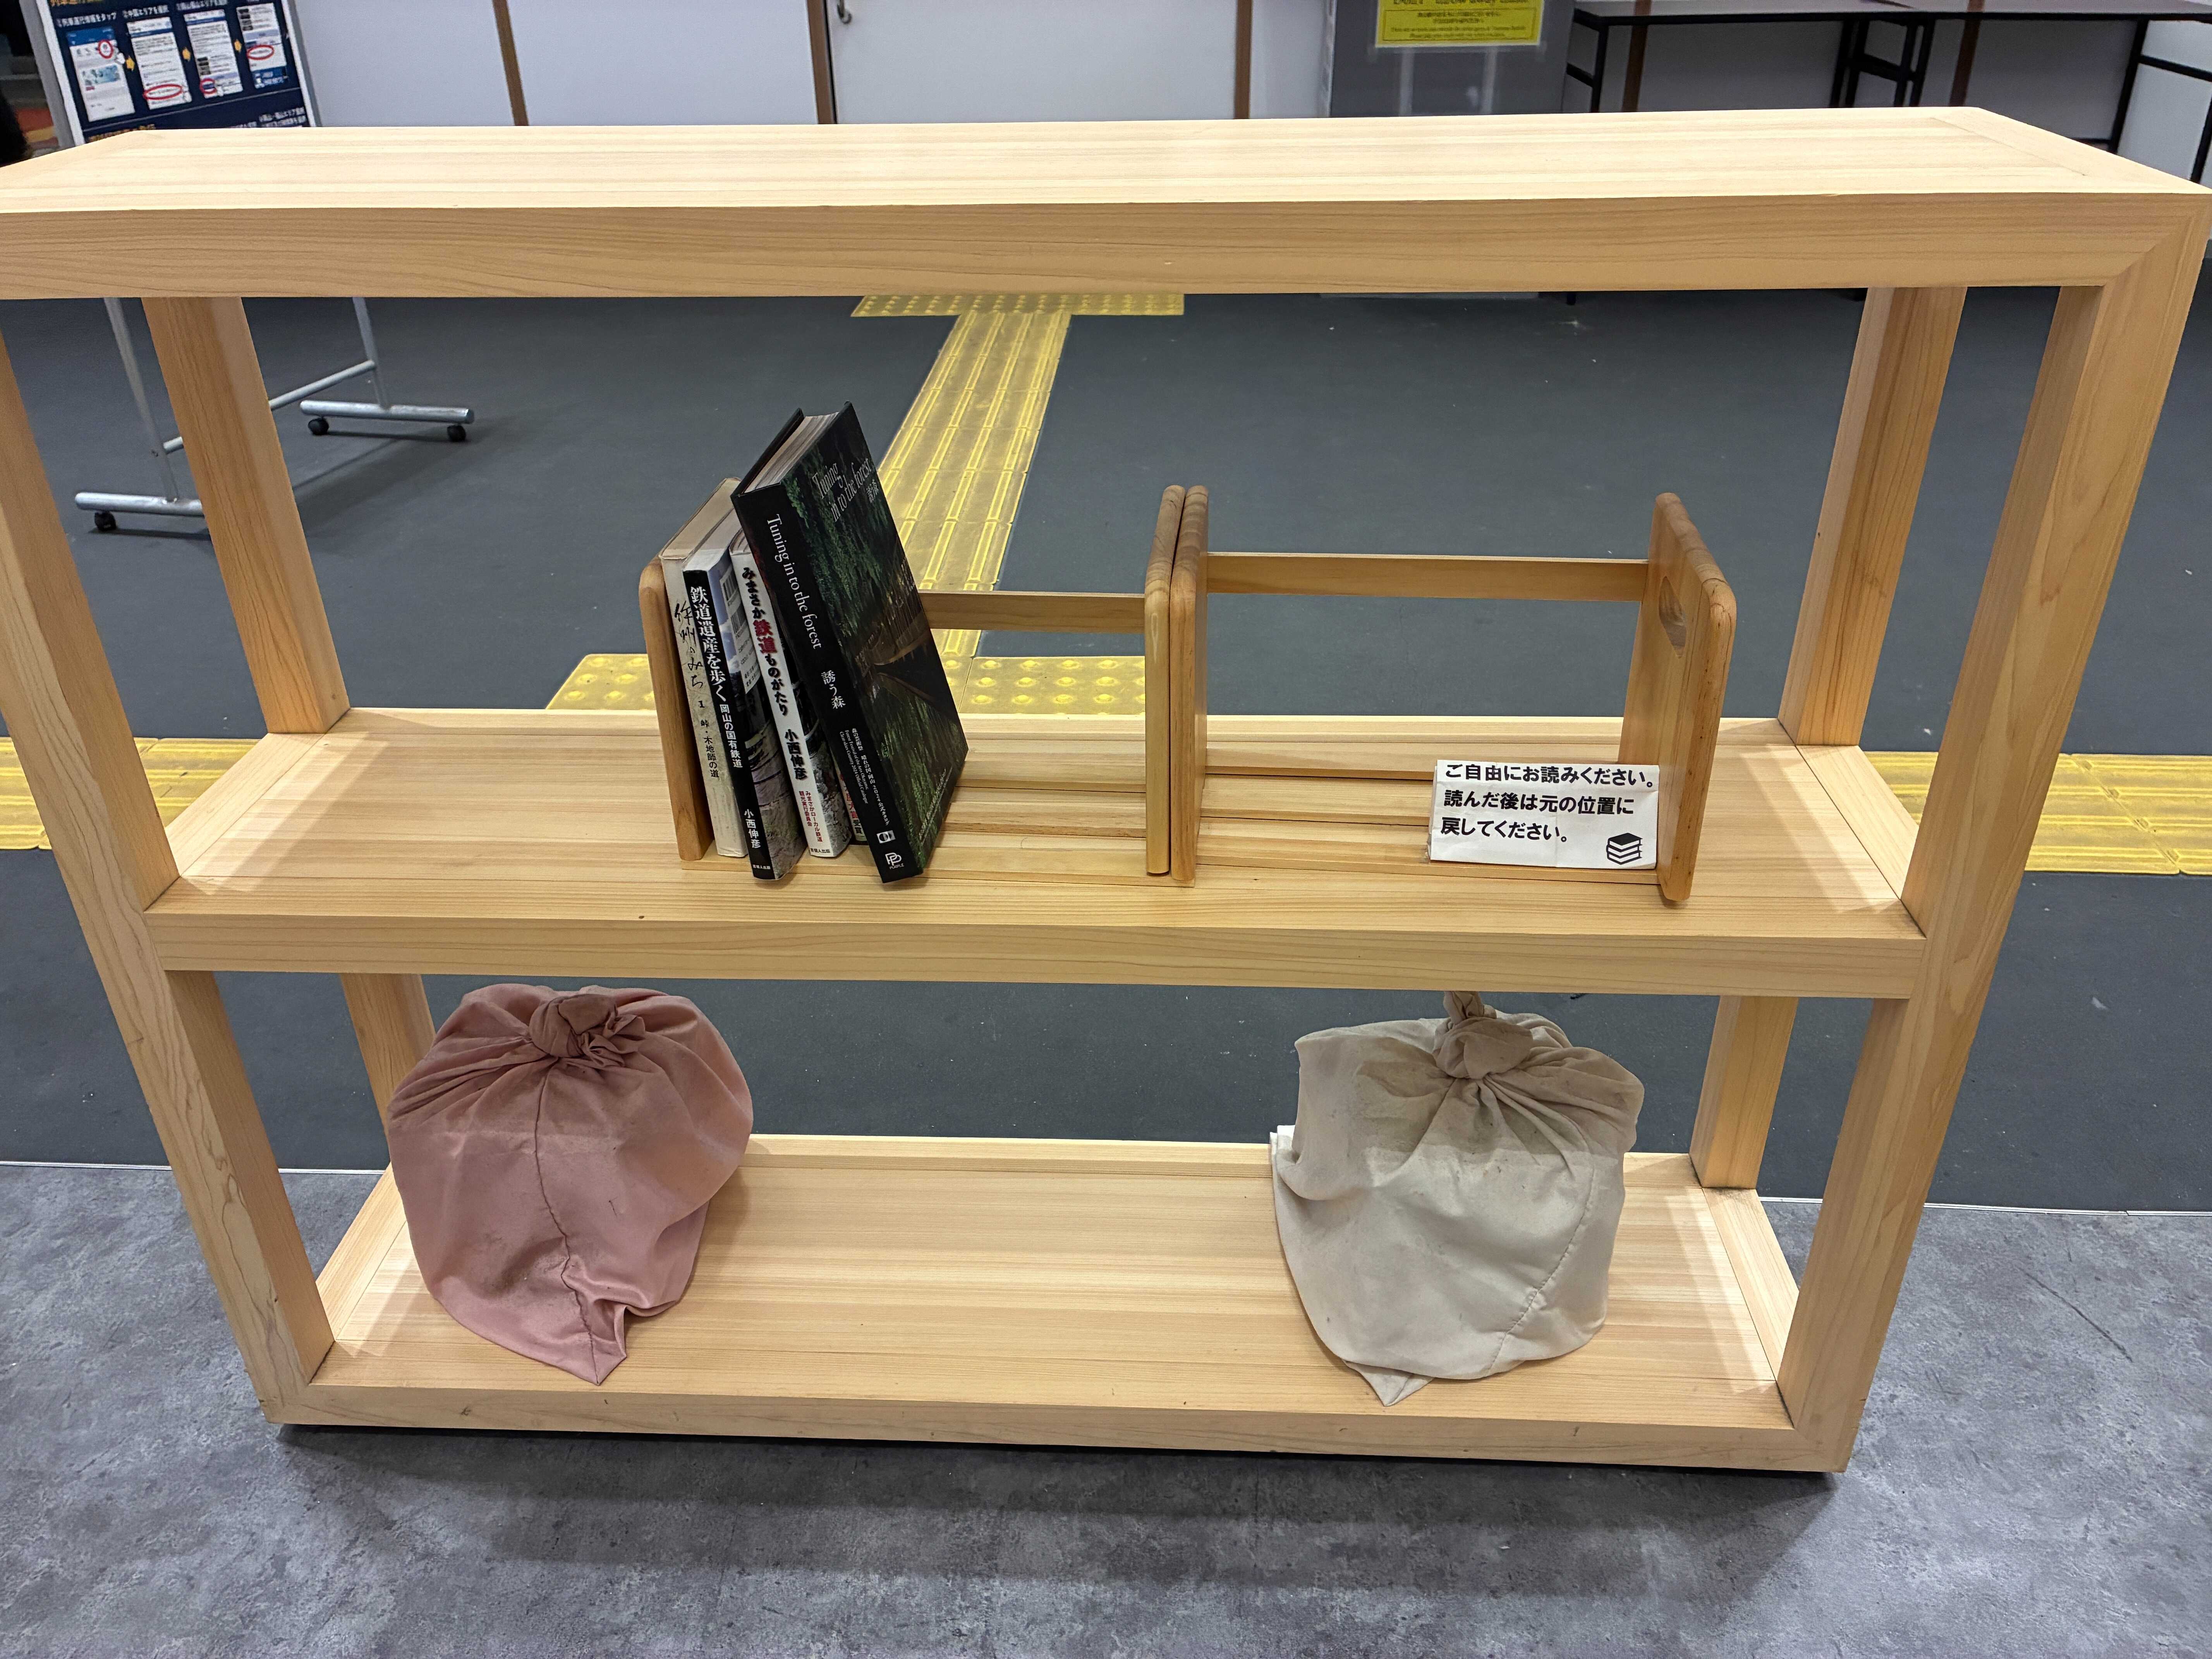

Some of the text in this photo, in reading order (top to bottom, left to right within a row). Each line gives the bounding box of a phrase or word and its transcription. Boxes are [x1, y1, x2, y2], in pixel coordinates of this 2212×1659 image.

[812, 463, 843, 499] Tuning
[829, 458, 872, 522] in to the forest
[767, 514, 821, 649] Tuning in to the forest
[690, 586, 726, 702] 鉄道遺産を歩く
[742, 567, 788, 716] みまさか鉄道ものがたり
[821, 670, 846, 709] 誘う森
[701, 719, 720, 778] 峠・木地師の道
[720, 704, 743, 768] 岡山の国有鉄道
[785, 729, 808, 780] 小西伸彦
[1445, 764, 1653, 788] ご自由にお読みください。
[1444, 790, 1634, 814] 読んだ後は元の位置に
[744, 809, 761, 848] 小西伸彦
[1441, 817, 1567, 843] 戻してください。
